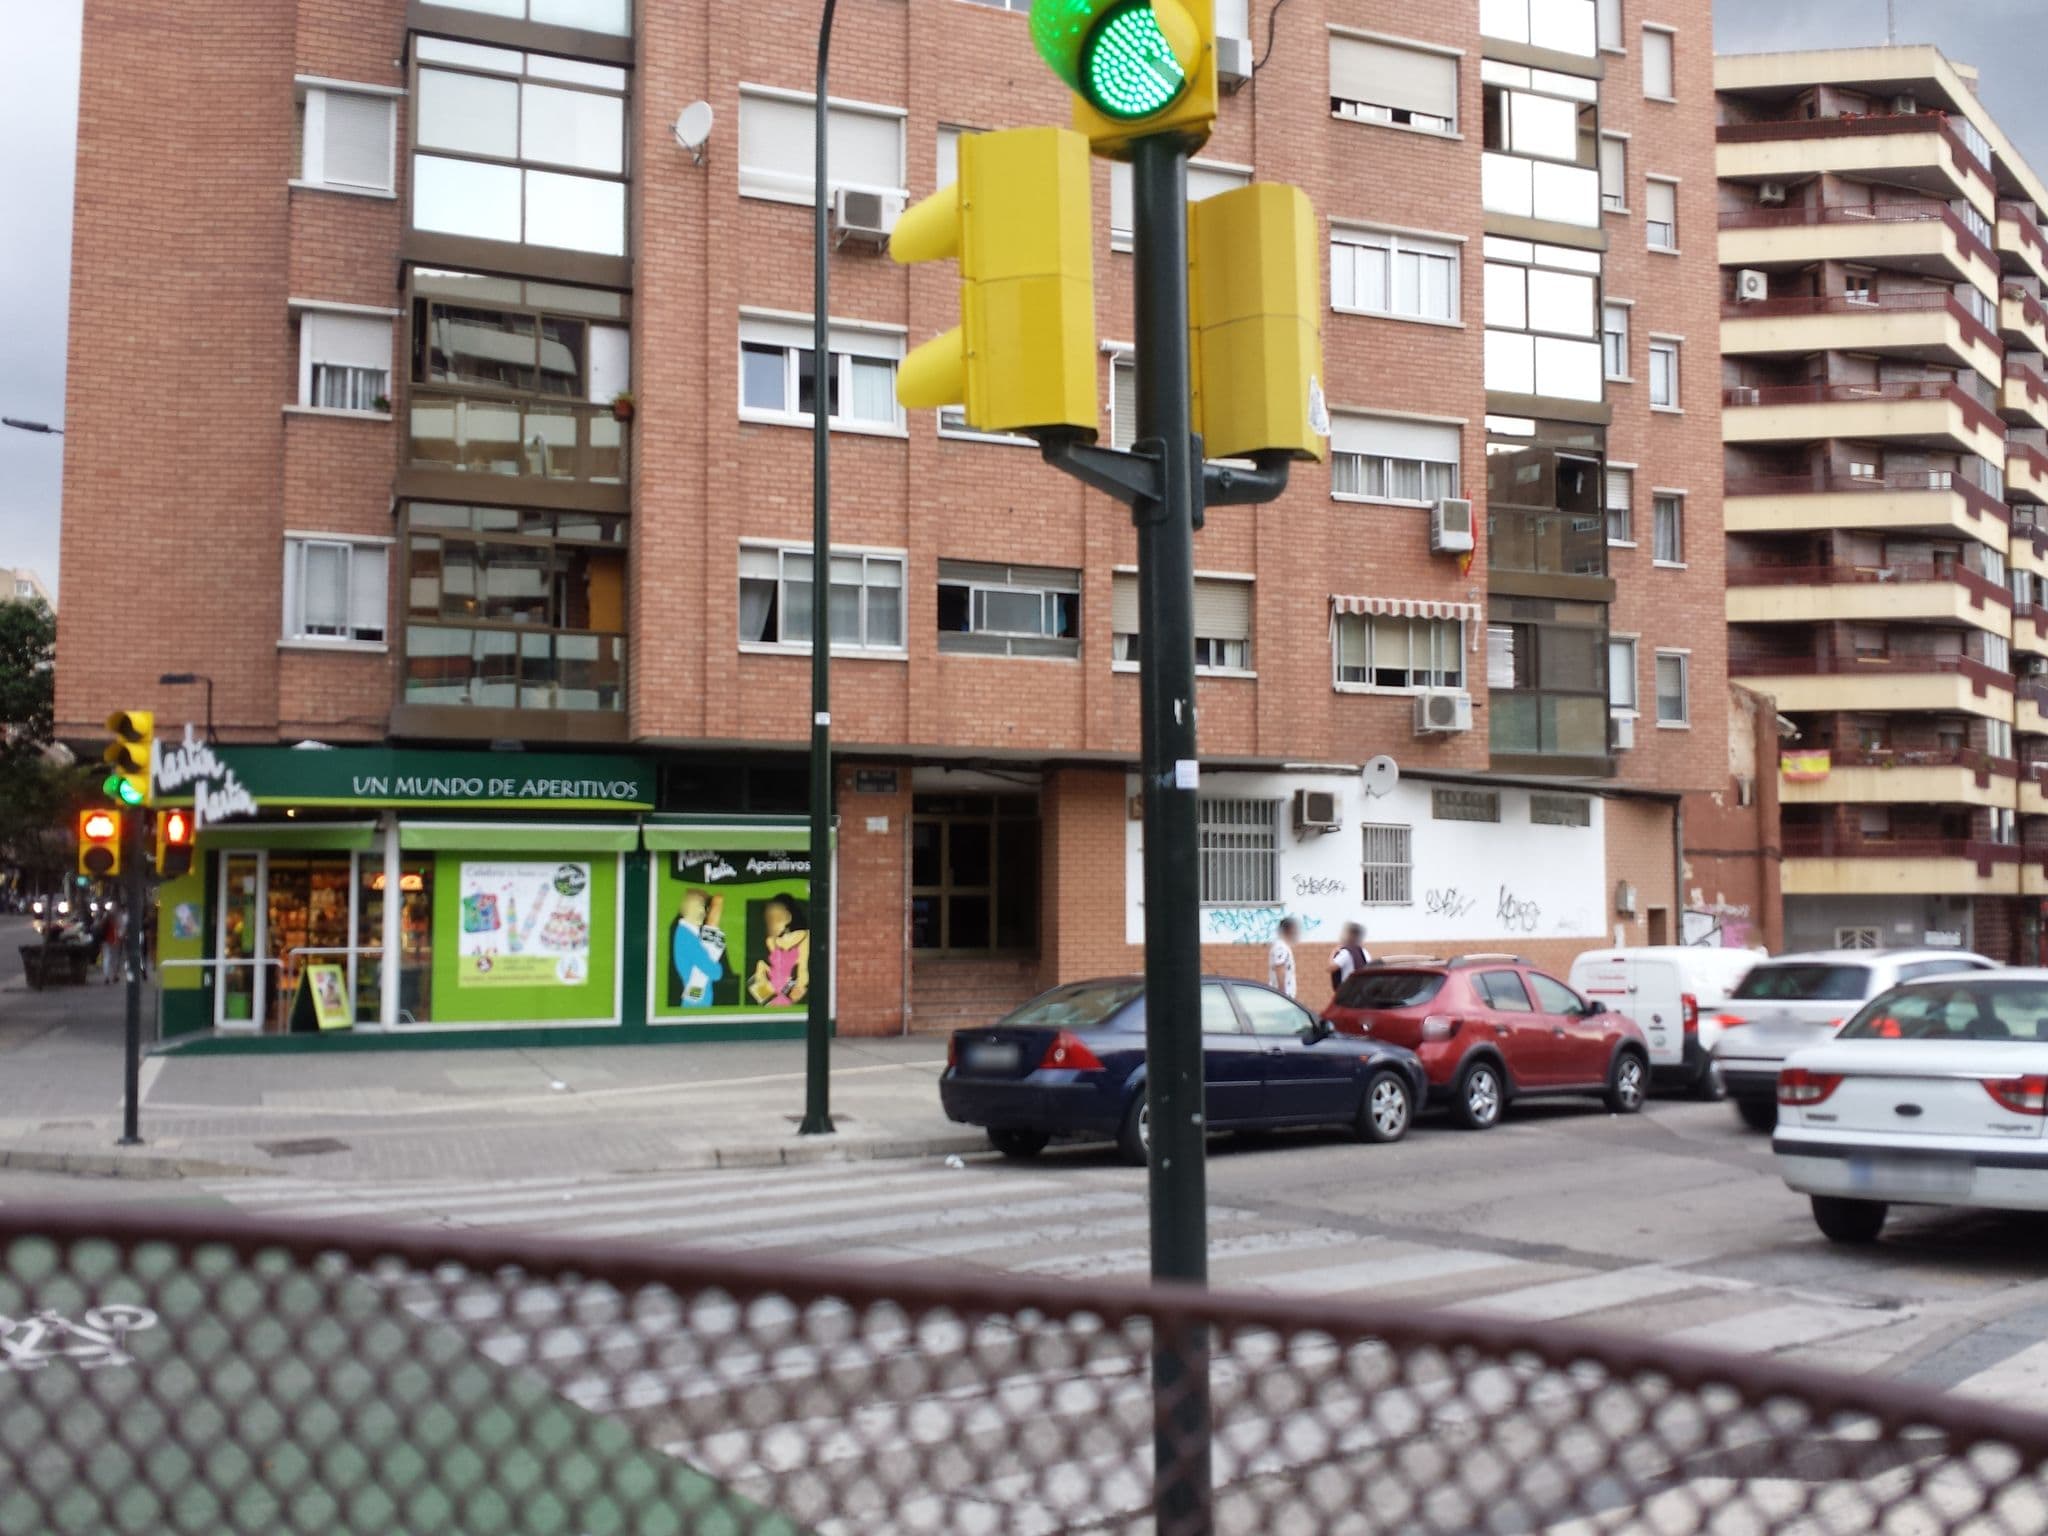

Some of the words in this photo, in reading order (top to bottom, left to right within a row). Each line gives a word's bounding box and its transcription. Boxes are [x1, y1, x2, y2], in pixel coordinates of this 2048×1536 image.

[352, 775, 389, 796] UN
[394, 776, 484, 797] MUNDO
[488, 778, 516, 798] DE
[518, 778, 639, 801] APERITIVOS
[746, 856, 811, 875] Aperitivos
